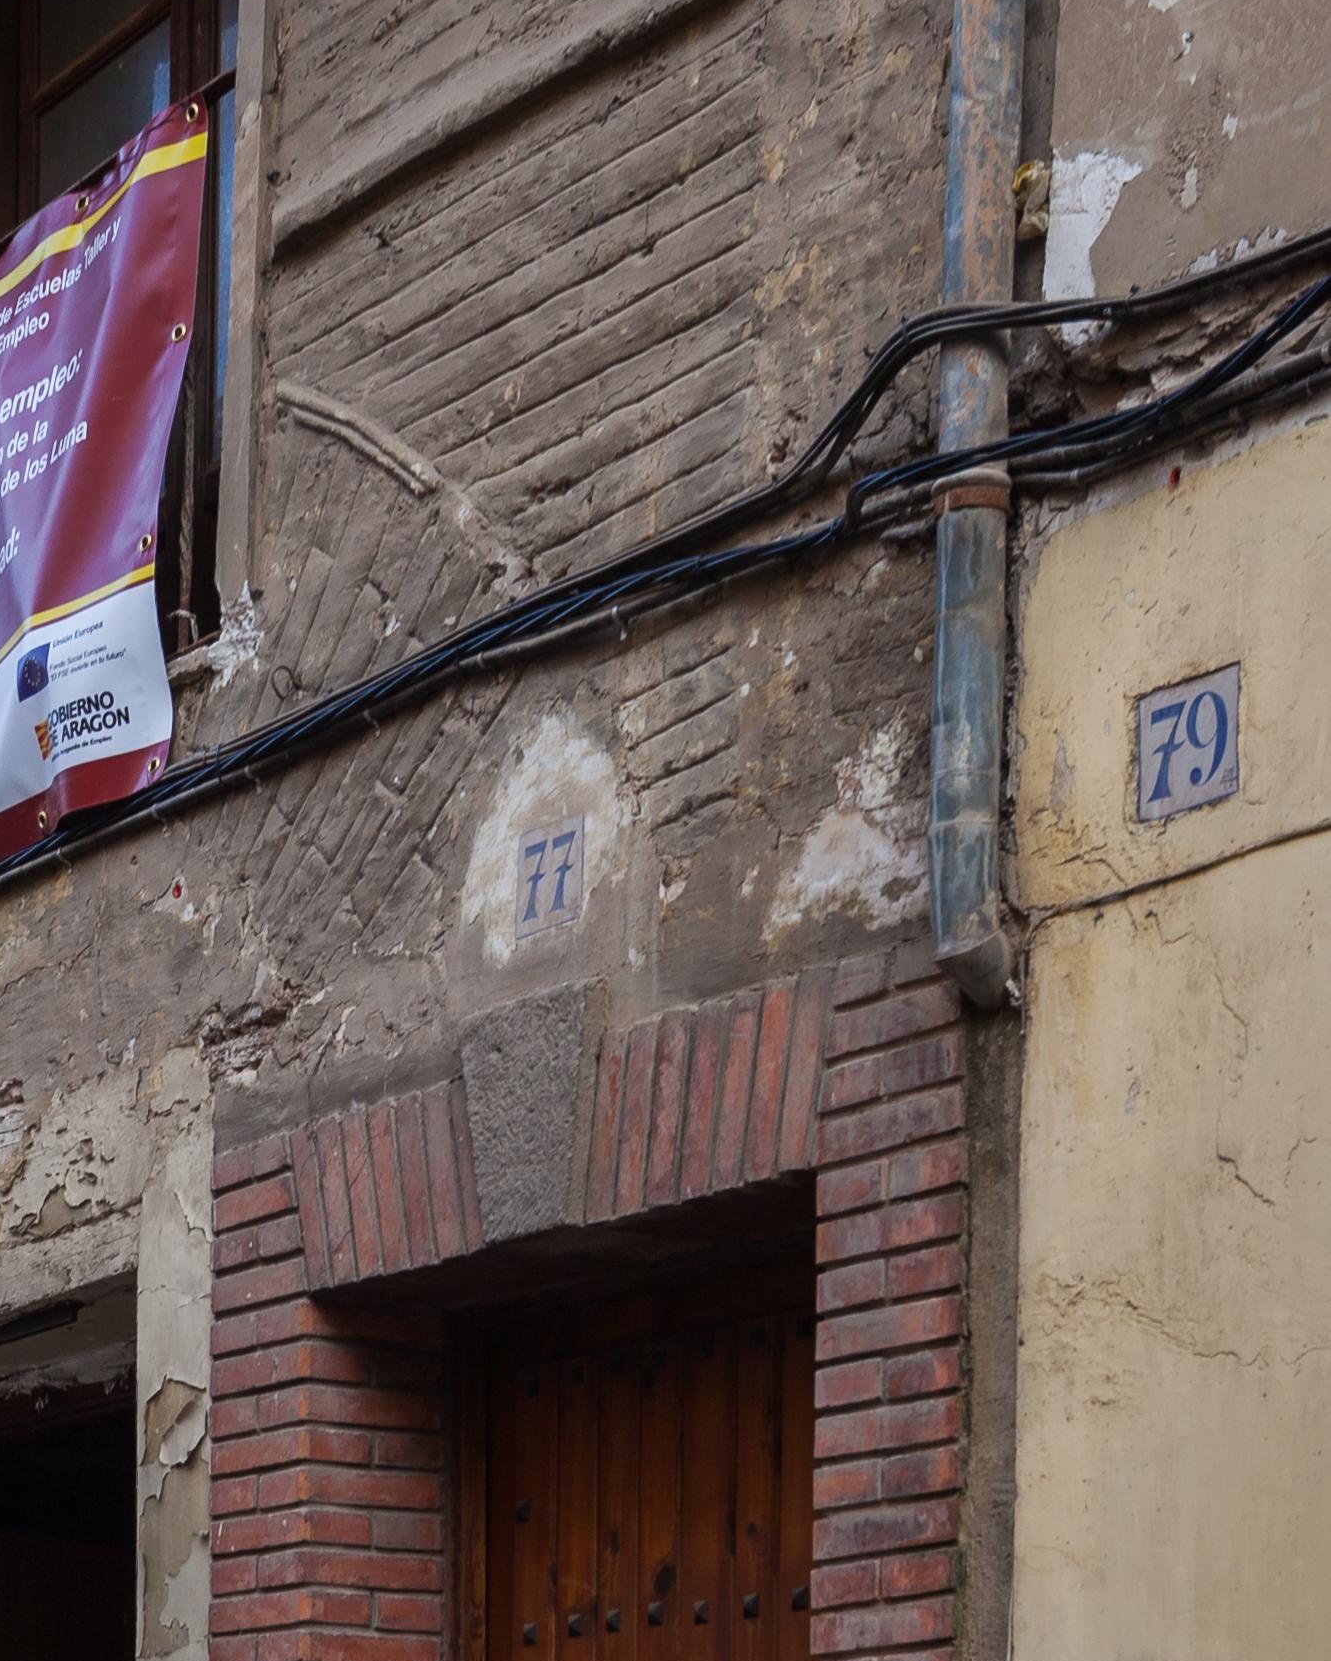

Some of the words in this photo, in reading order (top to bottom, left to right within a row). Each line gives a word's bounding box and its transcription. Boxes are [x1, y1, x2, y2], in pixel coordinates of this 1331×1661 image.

[15, 266, 81, 316] Escuelas
[84, 234, 111, 270] Taller
[111, 216, 122, 242] y
[0, 348, 83, 424] empleo:
[0, 469, 20, 498] de
[23, 453, 48, 484] los
[50, 420, 88, 464] Luna
[6, 430, 28, 459] de
[33, 420, 49, 445] la
[74, 621, 103, 640] Europea
[61, 706, 130, 743] ARAGON
[1147, 691, 1228, 803] 79
[521, 830, 577, 924] 77
